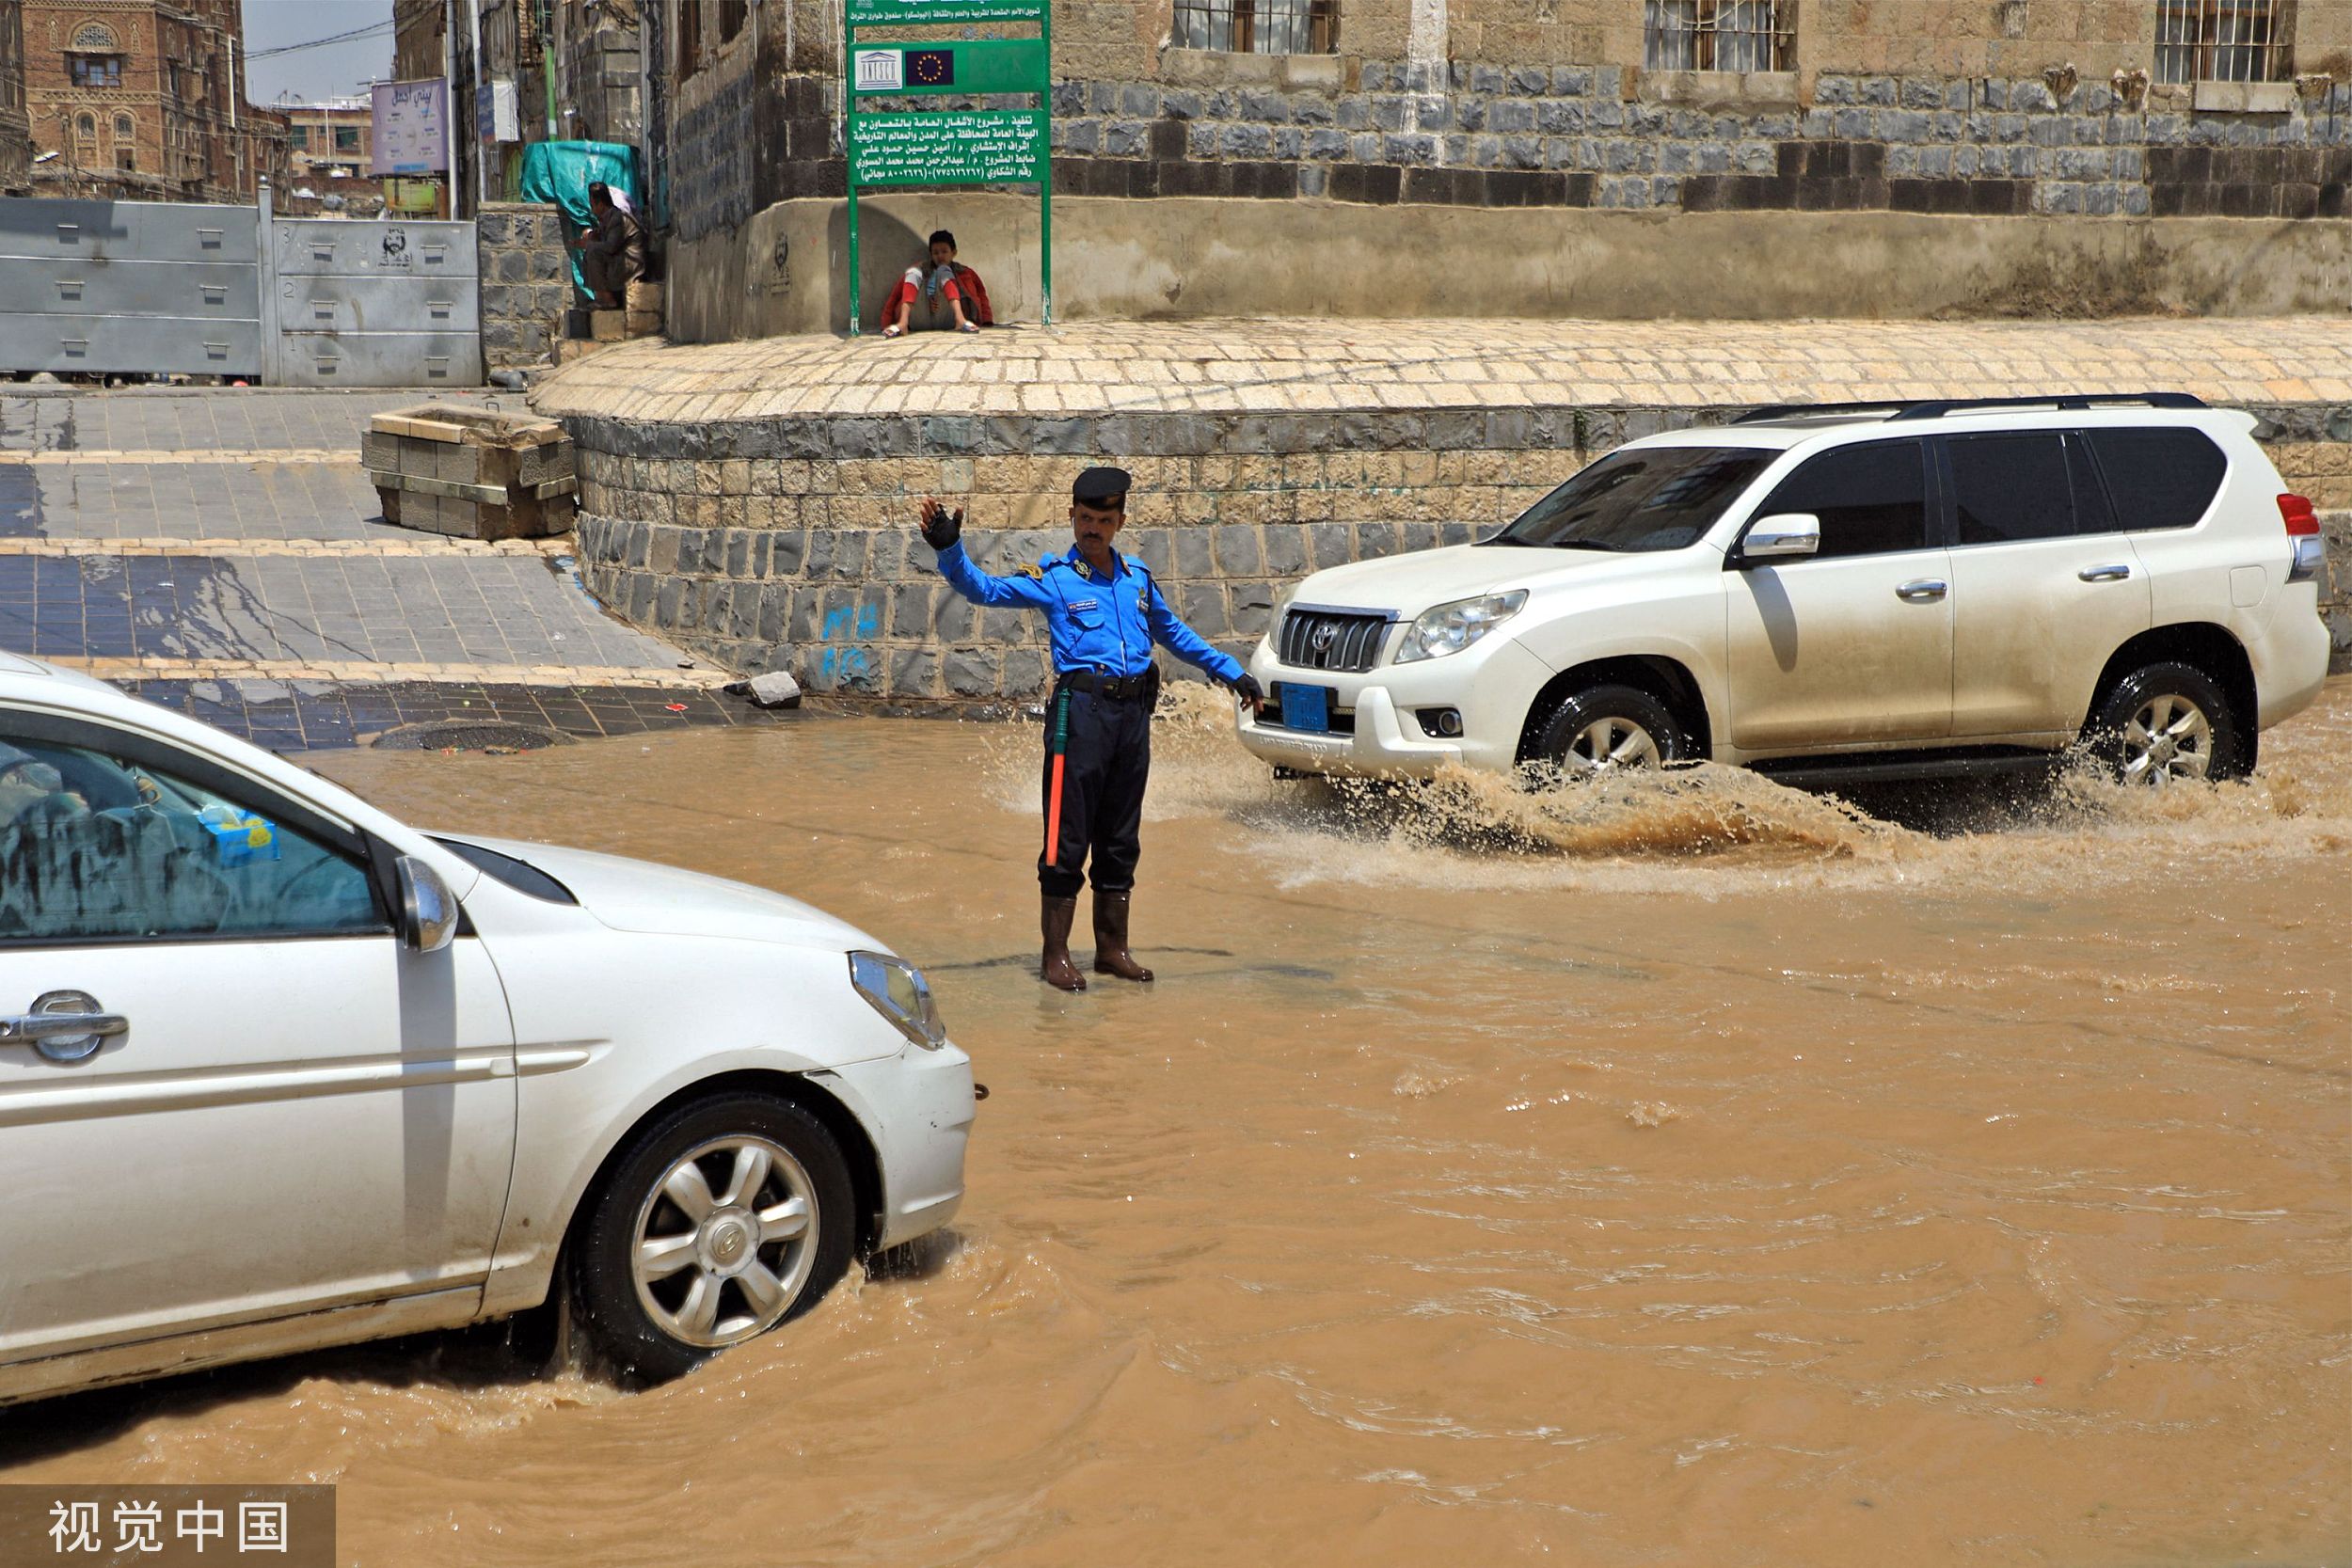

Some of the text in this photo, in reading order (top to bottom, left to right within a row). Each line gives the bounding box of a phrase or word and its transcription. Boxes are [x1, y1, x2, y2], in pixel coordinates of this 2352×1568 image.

[859, 121, 866, 131] مع
[914, 117, 942, 127] العامة
[889, 132, 917, 141] والمعالم
[919, 131, 939, 141] المدن
[993, 128, 1013, 137] العامة
[861, 145, 880, 157] علي
[882, 146, 902, 154] حمود
[906, 144, 929, 154] حسين
[283, 281, 294, 298] 2
